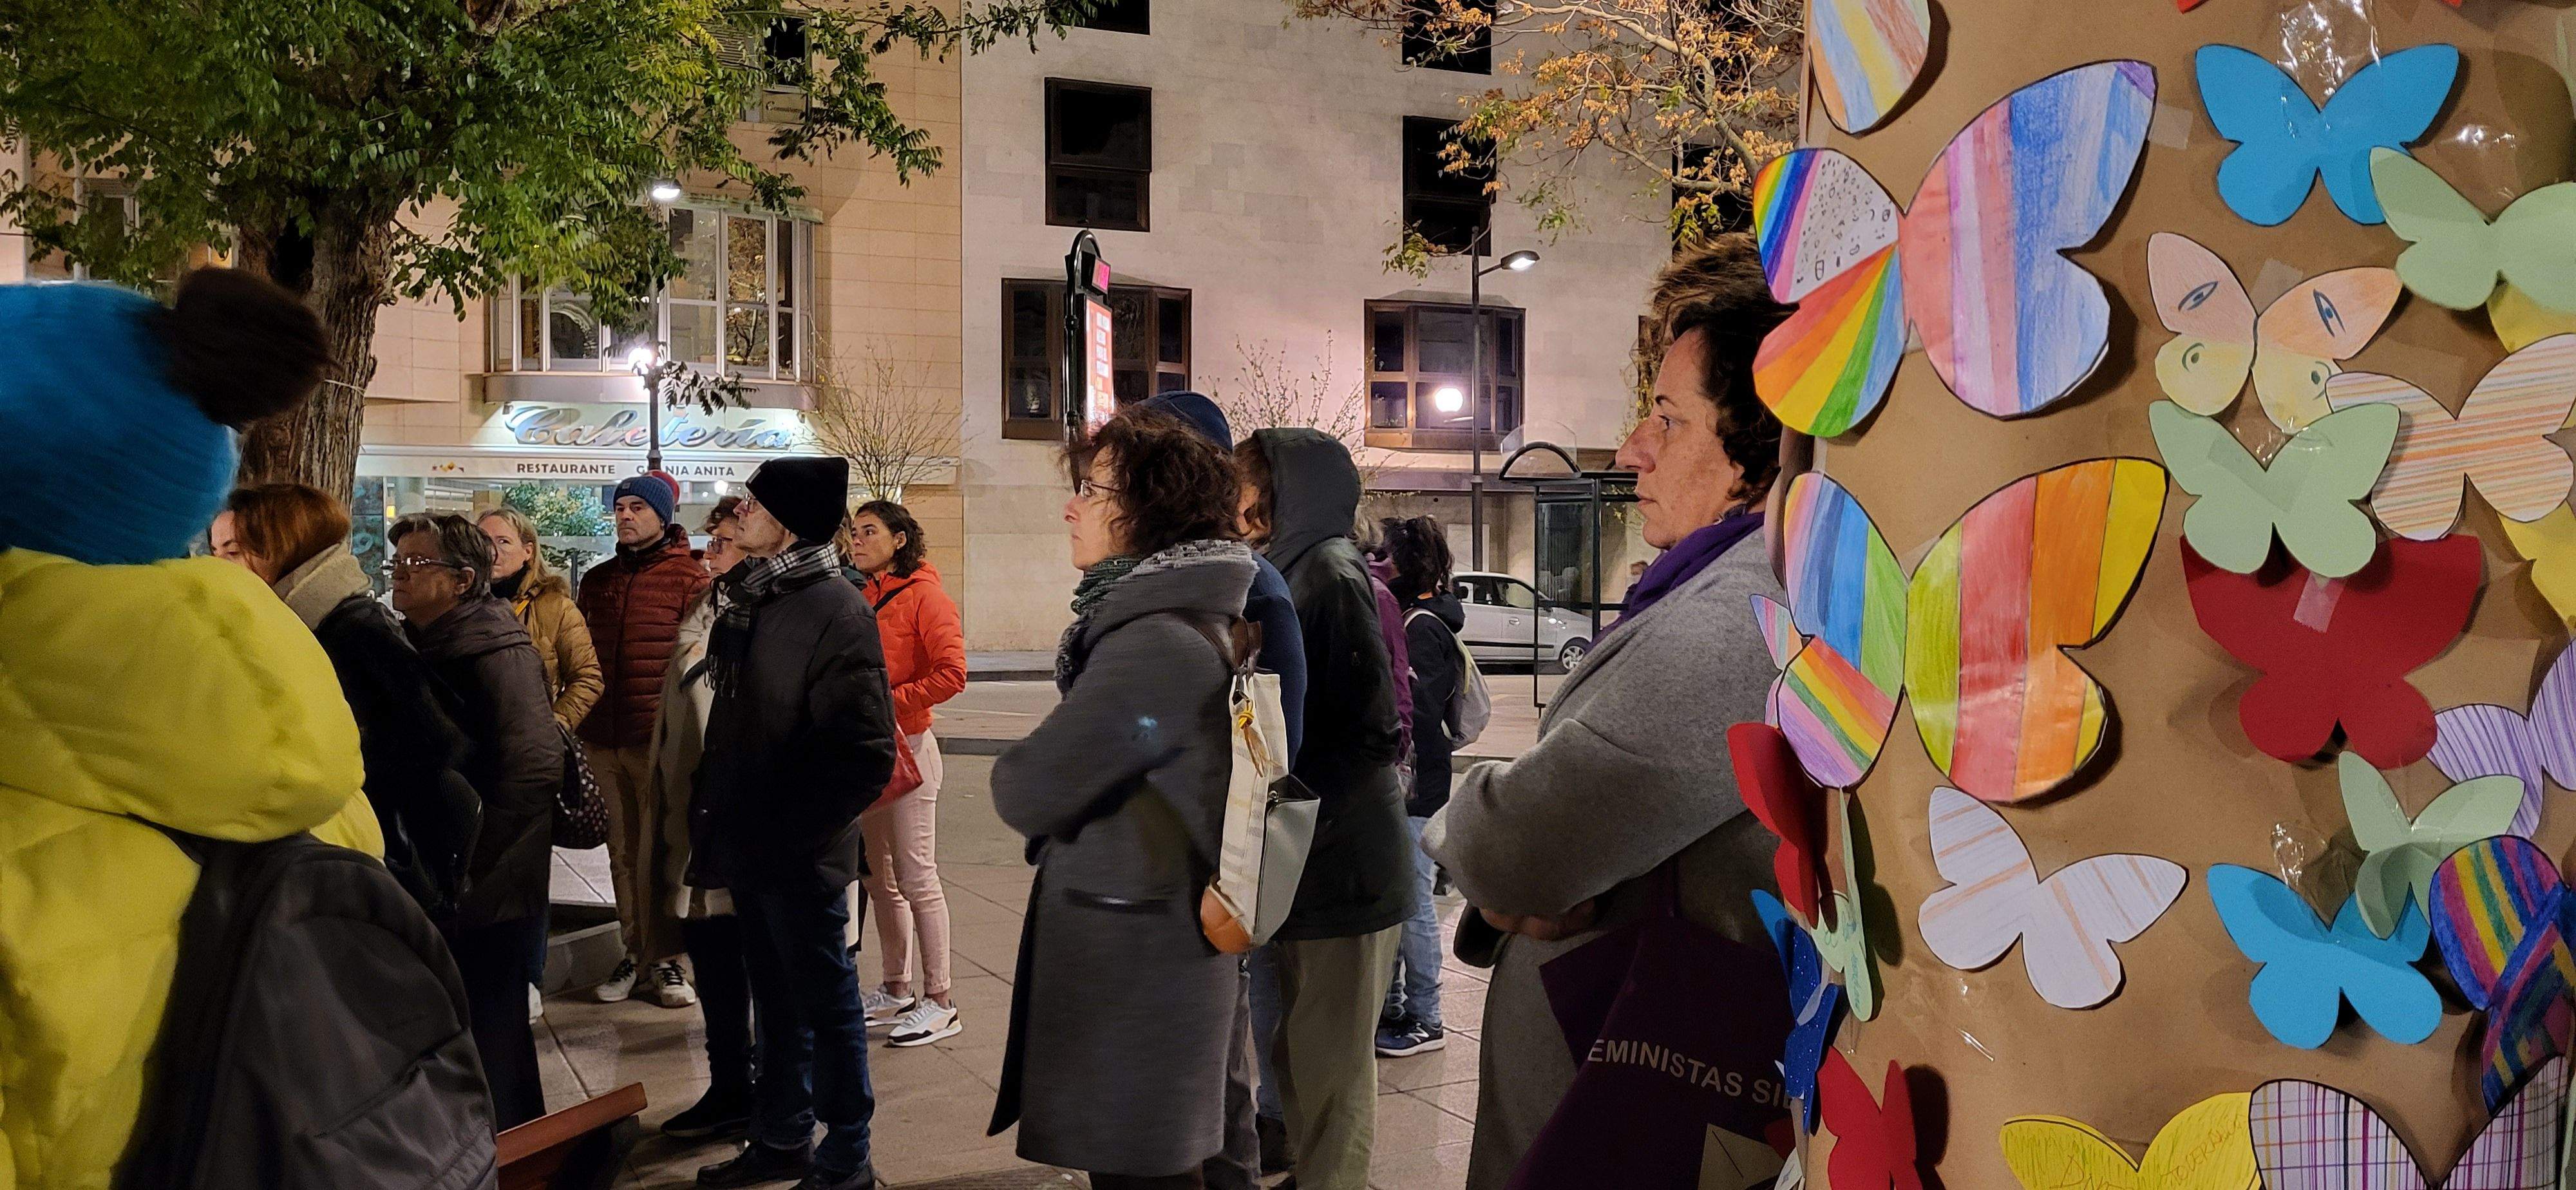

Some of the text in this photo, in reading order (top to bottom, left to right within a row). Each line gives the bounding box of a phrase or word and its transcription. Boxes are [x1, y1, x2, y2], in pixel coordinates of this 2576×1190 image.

[516, 463, 735, 477] RESTAURANTE GNJA ANITA
[1587, 1038, 1743, 1097] EMINISTAS
